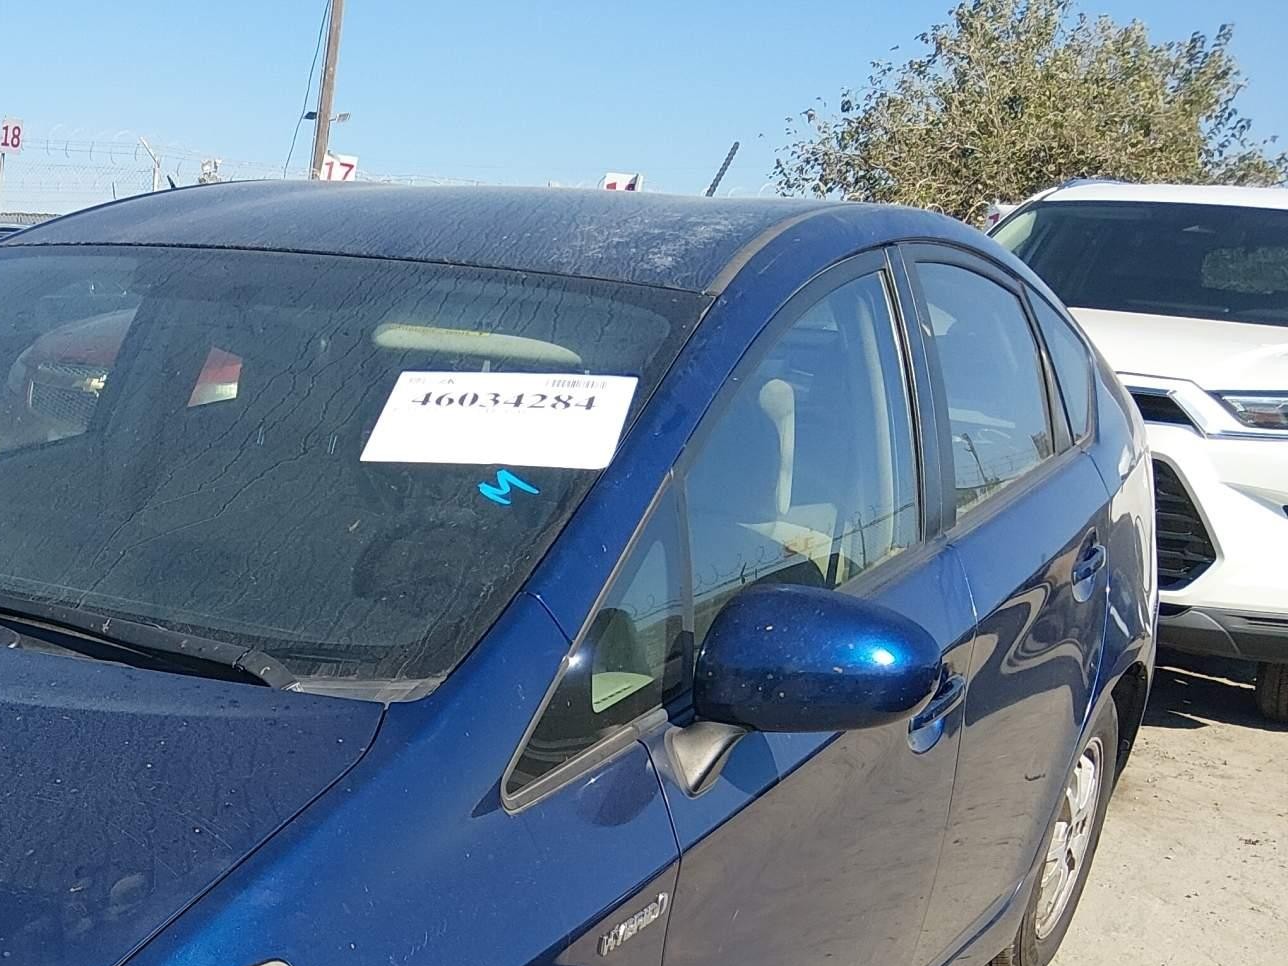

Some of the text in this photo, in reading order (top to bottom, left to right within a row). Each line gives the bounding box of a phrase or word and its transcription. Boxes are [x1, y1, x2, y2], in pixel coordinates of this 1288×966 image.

[1, 125, 21, 148] 18
[324, 161, 355, 181] 17
[411, 391, 597, 411] 46034284
